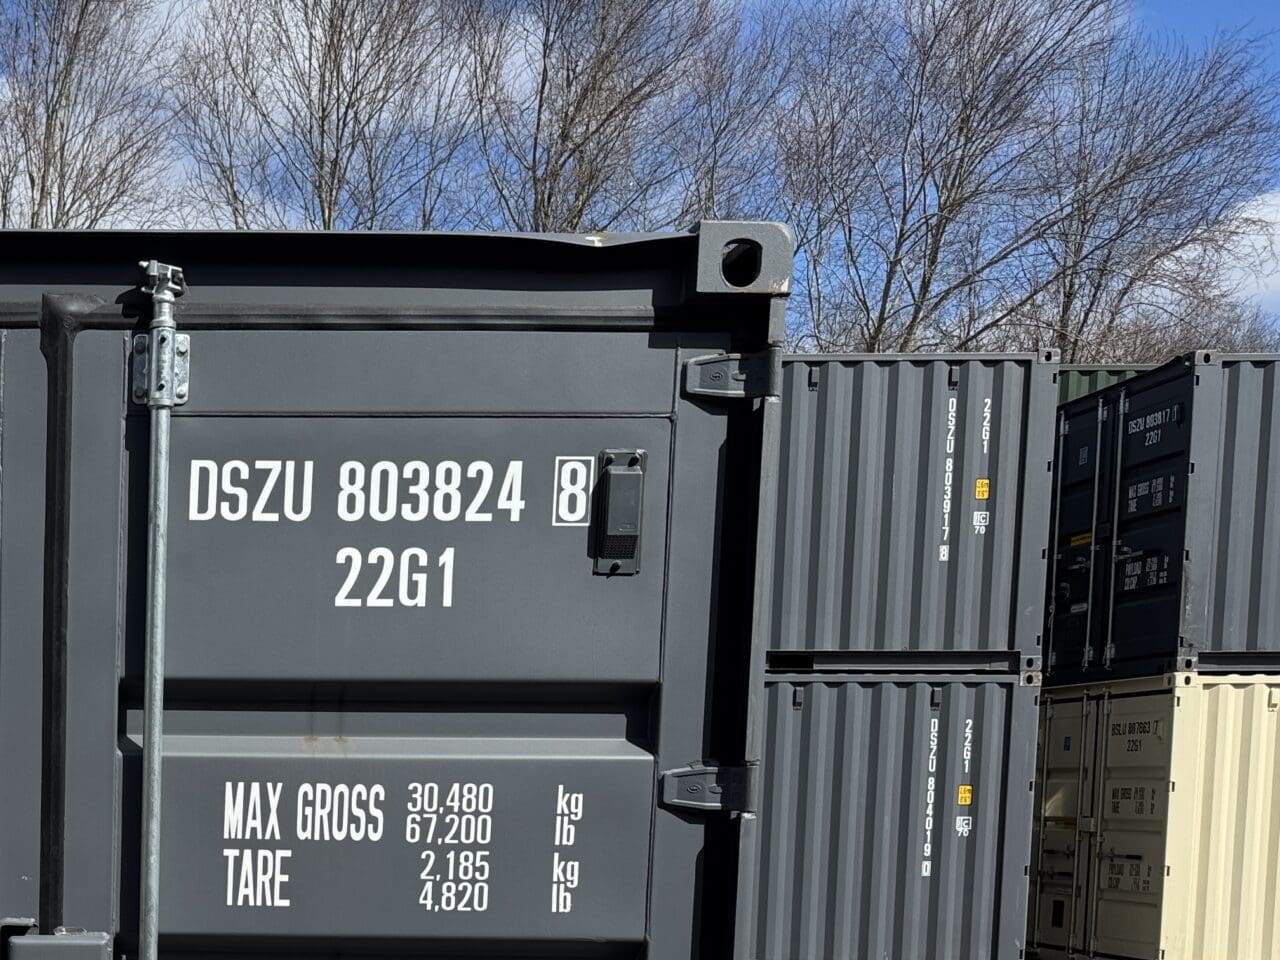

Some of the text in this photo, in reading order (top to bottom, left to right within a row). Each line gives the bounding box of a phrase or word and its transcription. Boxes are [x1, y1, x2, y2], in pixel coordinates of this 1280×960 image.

[945, 397, 957, 454] DSZU
[981, 398, 992, 454] 22G1
[188, 459, 589, 523] DSZU 803824 8
[941, 457, 953, 541] 803917
[974, 526, 986, 534] 70
[334, 547, 455, 608] 22G1
[928, 718, 939, 772] DSZU
[963, 719, 973, 773] 22G1
[223, 782, 584, 841] MAX GROSS 30,480 kg
[405, 813, 575, 846] 67,200 lb
[923, 776, 935, 857] 804019
[223, 849, 580, 907] TARE 2,185 kg
[418, 881, 572, 913] 4,820 lb
